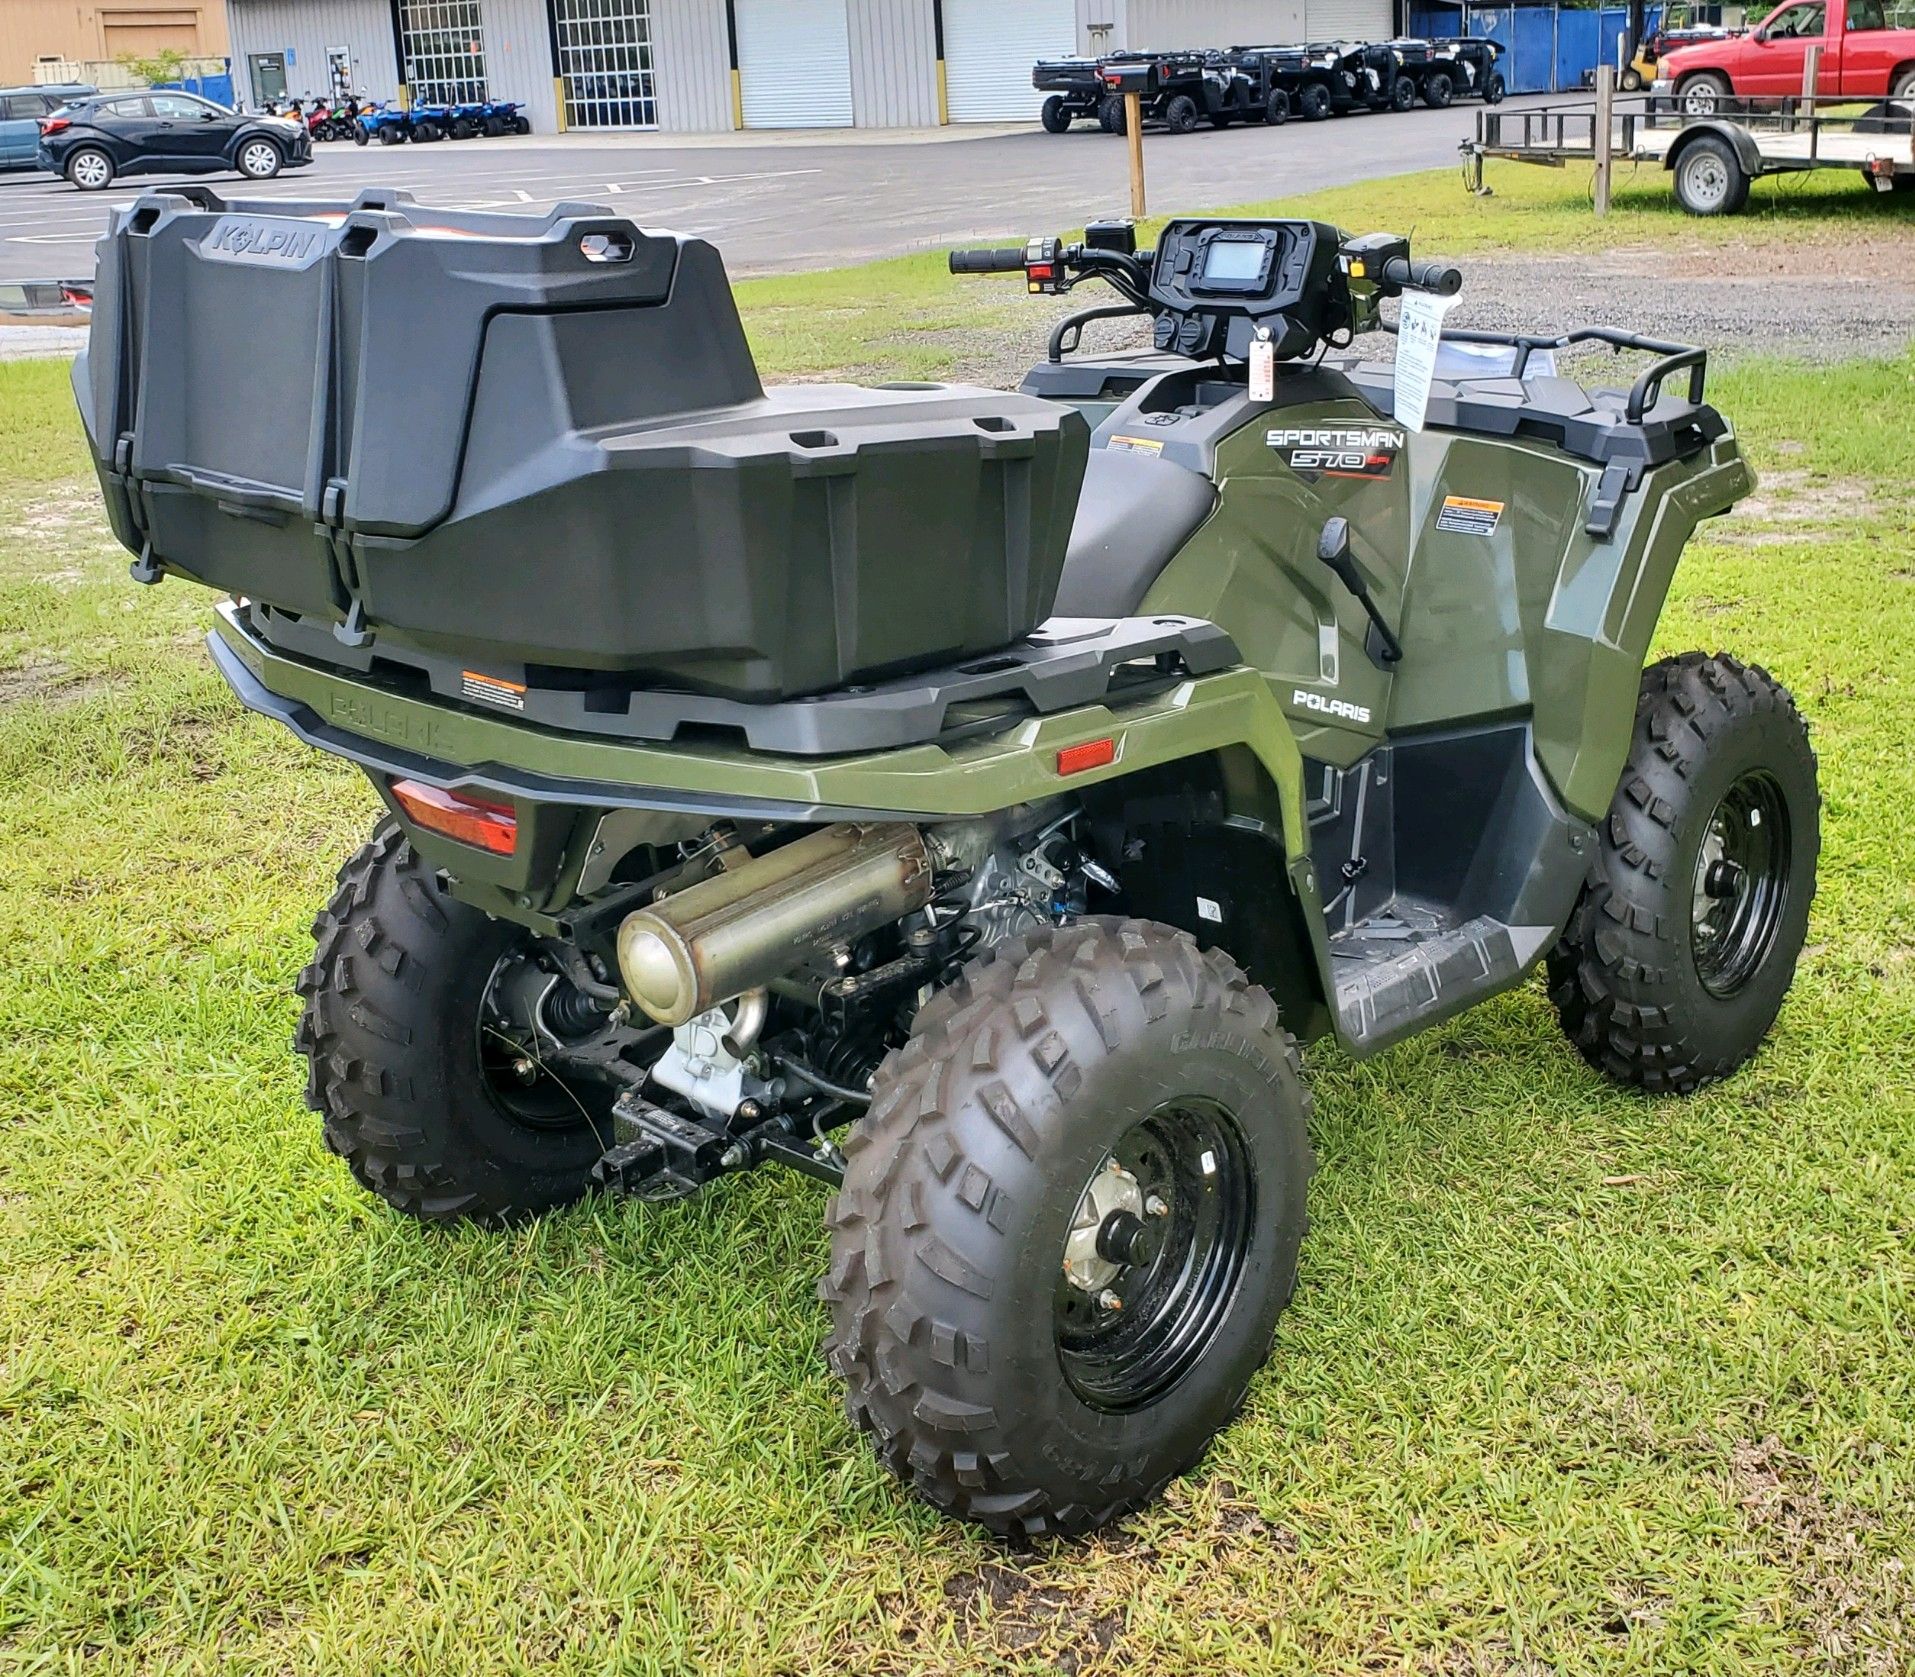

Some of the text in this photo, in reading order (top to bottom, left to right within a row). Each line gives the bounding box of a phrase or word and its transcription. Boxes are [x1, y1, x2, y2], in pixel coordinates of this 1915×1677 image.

[212, 225, 316, 258] KOLPIN
[1265, 429, 1404, 449] SPORTSMAN
[1290, 449, 1366, 469] 570
[1292, 689, 1371, 723] POLARIS
